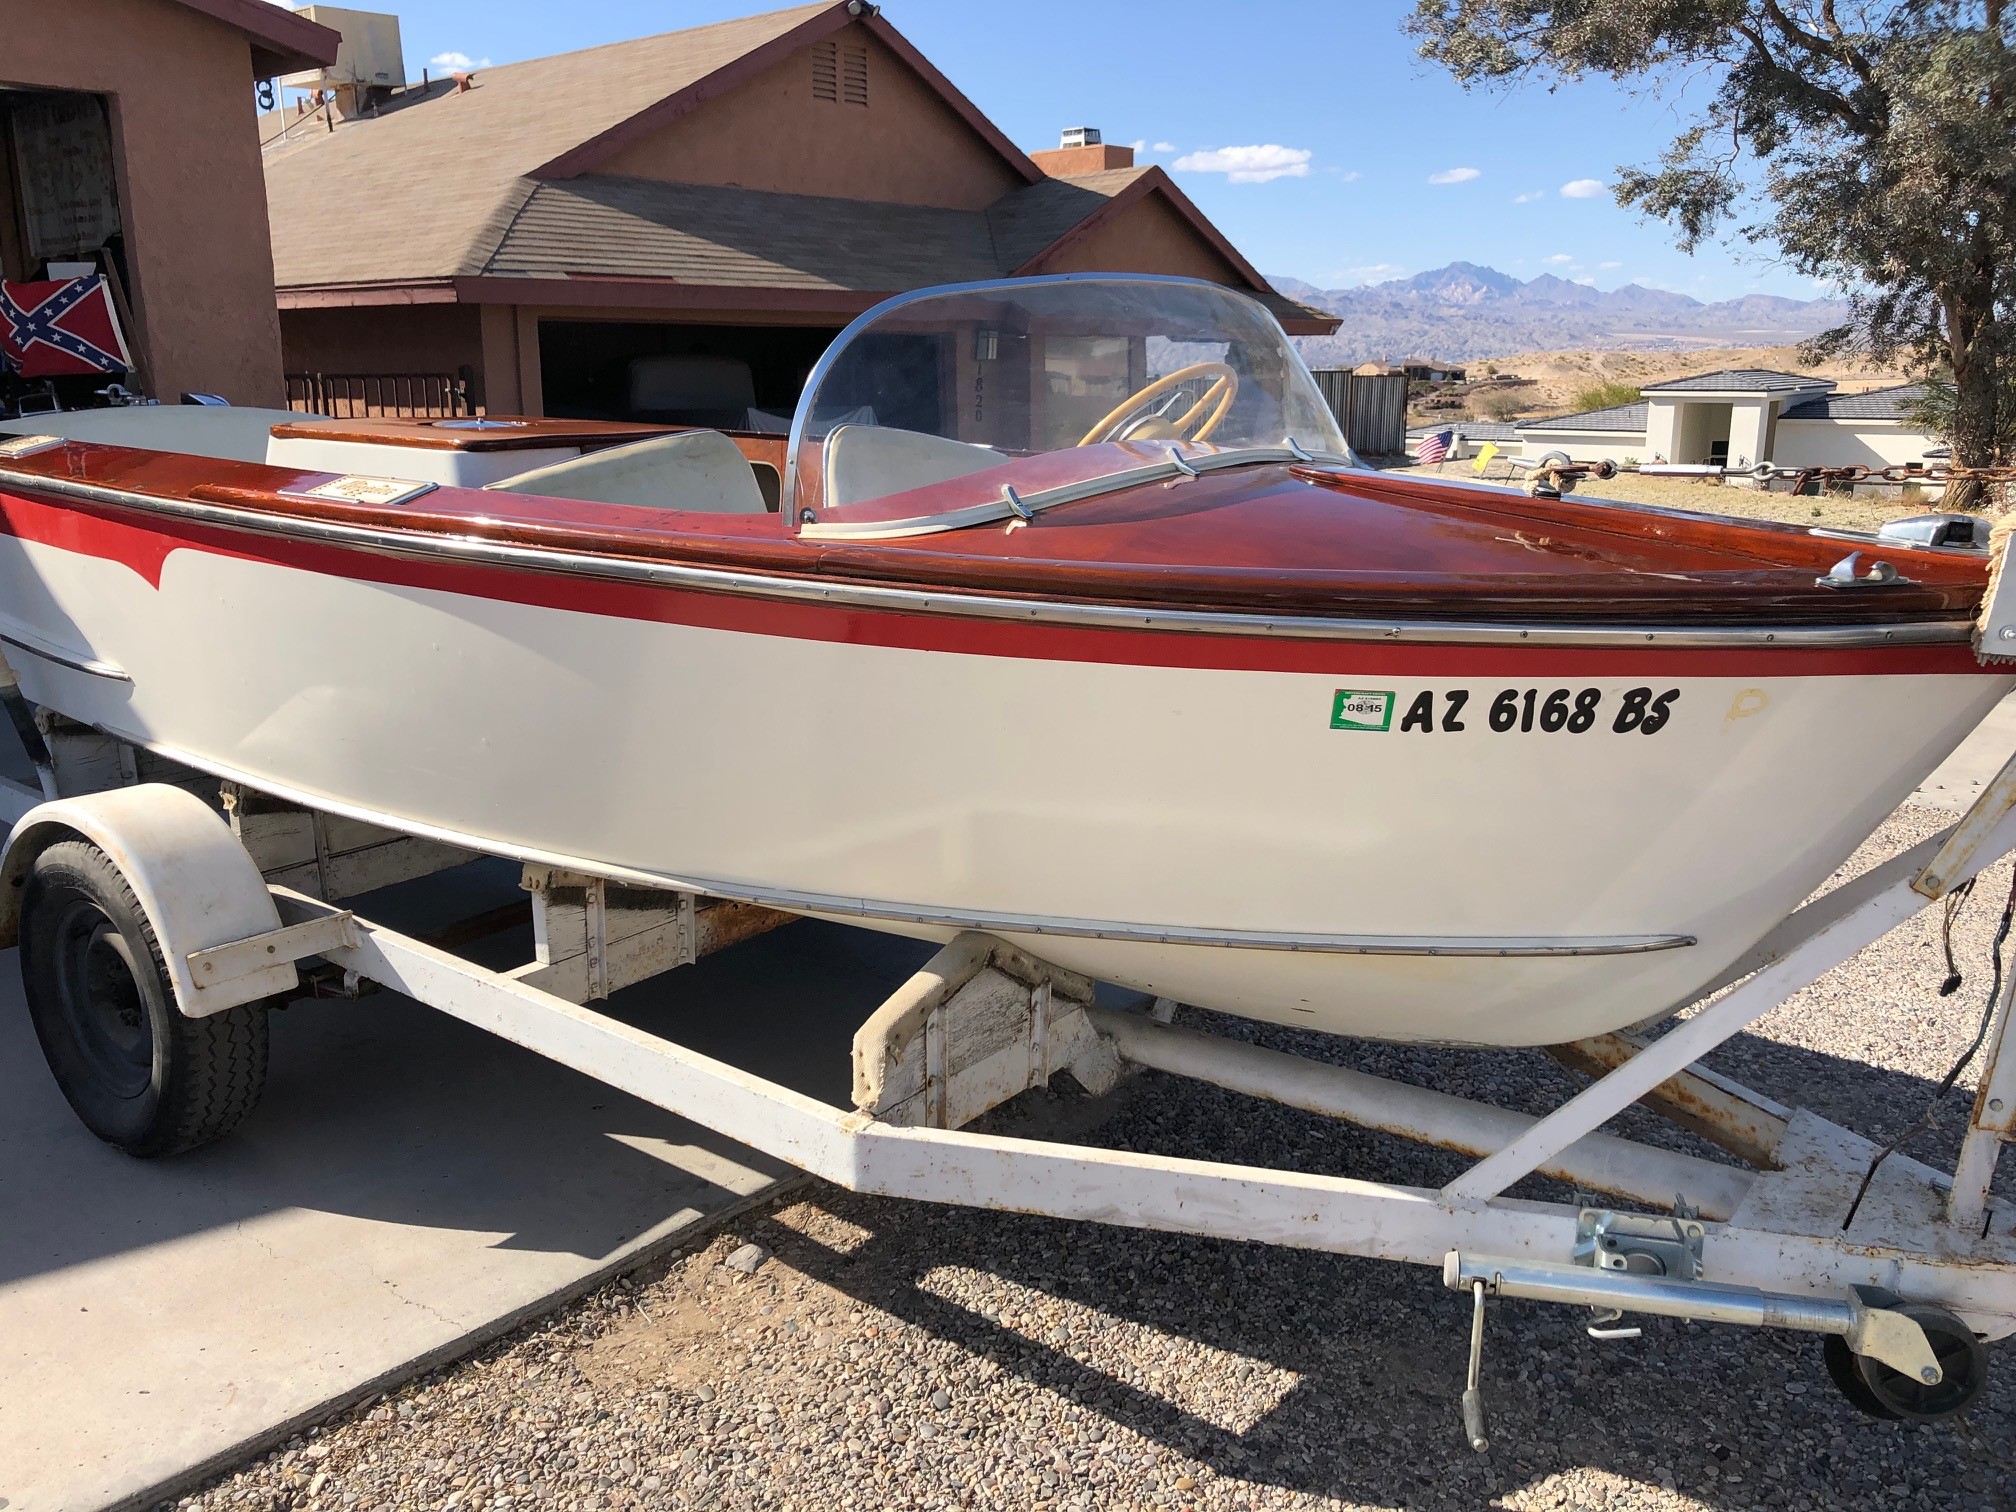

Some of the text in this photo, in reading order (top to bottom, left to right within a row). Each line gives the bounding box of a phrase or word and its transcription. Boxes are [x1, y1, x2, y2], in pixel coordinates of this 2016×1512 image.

[975, 362, 983, 423] 1820
[1400, 686, 1681, 736] AZ 6168 BS
